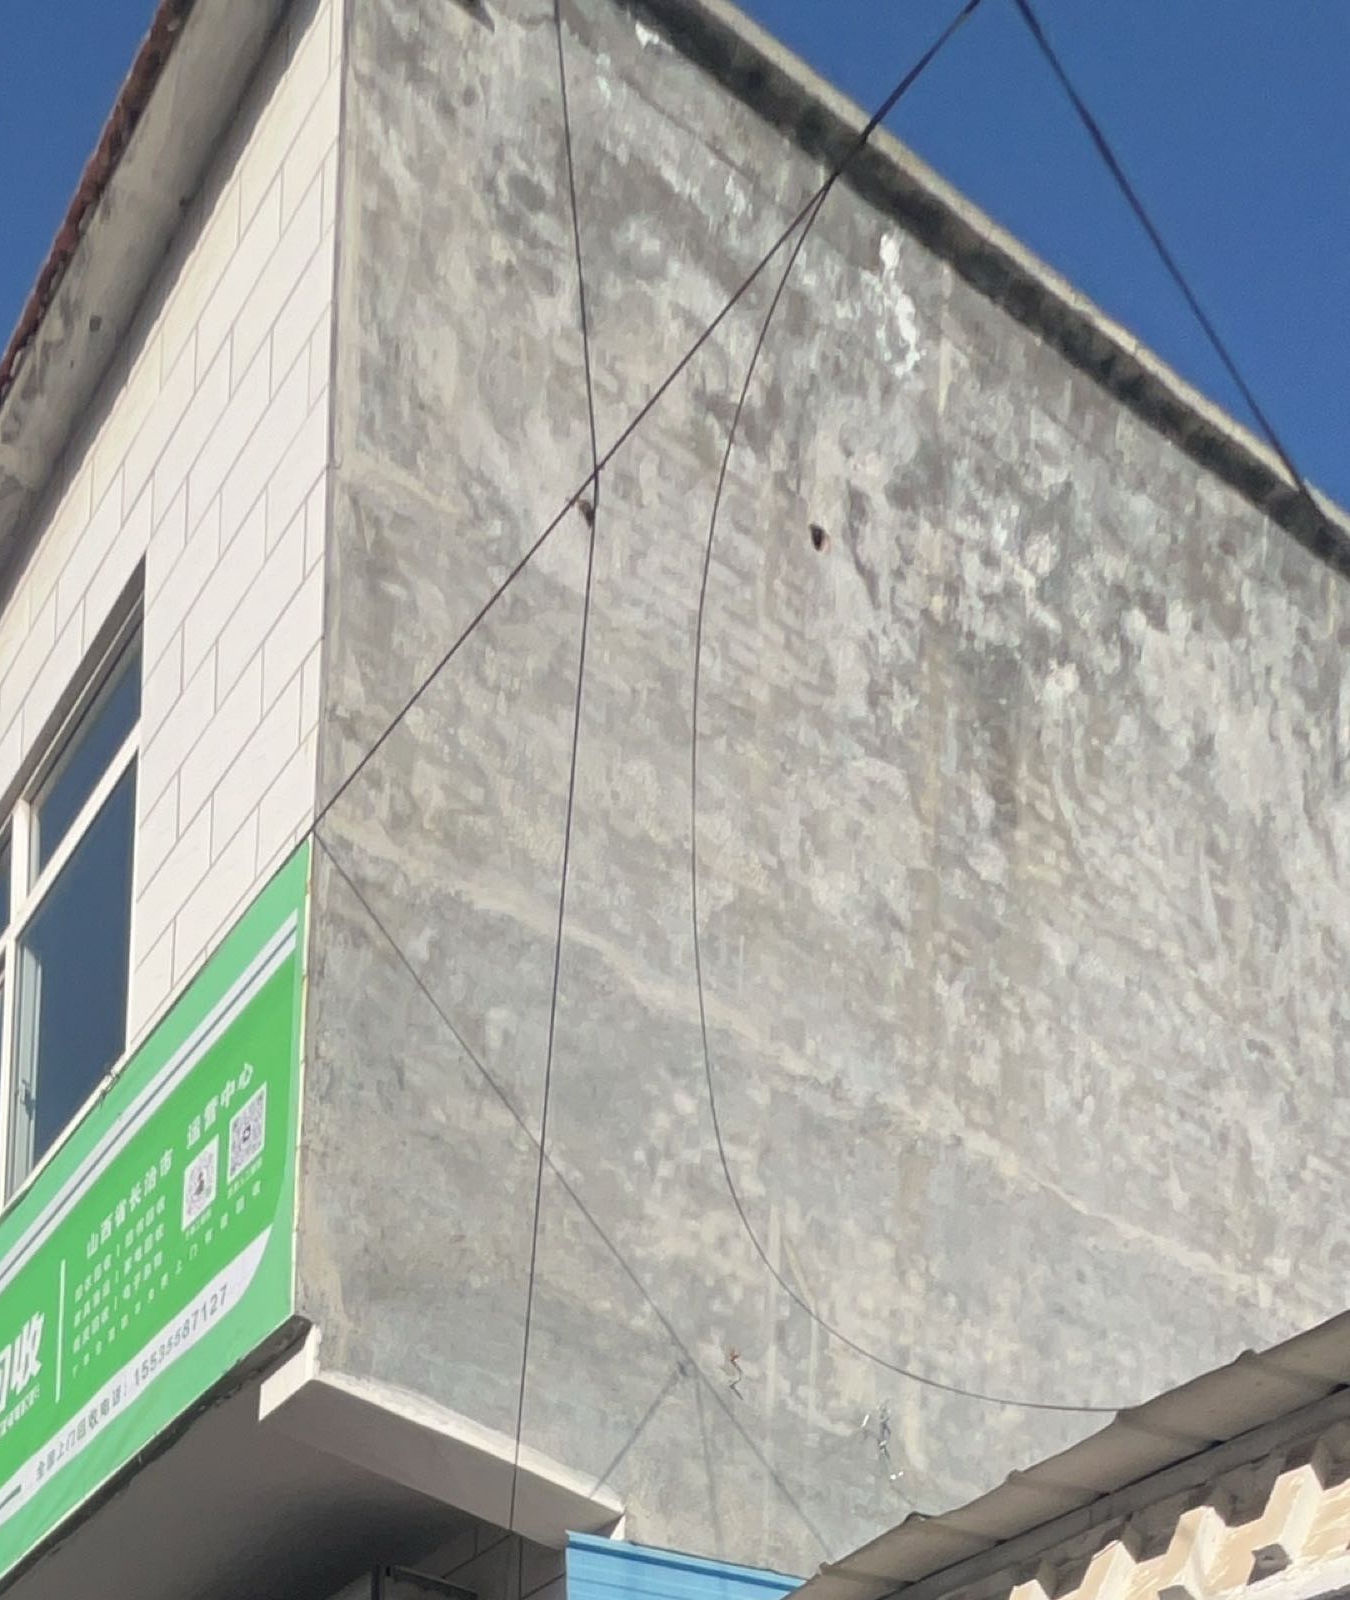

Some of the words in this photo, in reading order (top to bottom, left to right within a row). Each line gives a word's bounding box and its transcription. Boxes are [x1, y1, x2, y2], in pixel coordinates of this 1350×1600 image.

[87, 1148, 173, 1259] 山西省长治市
[187, 1062, 254, 1149] 运营中心
